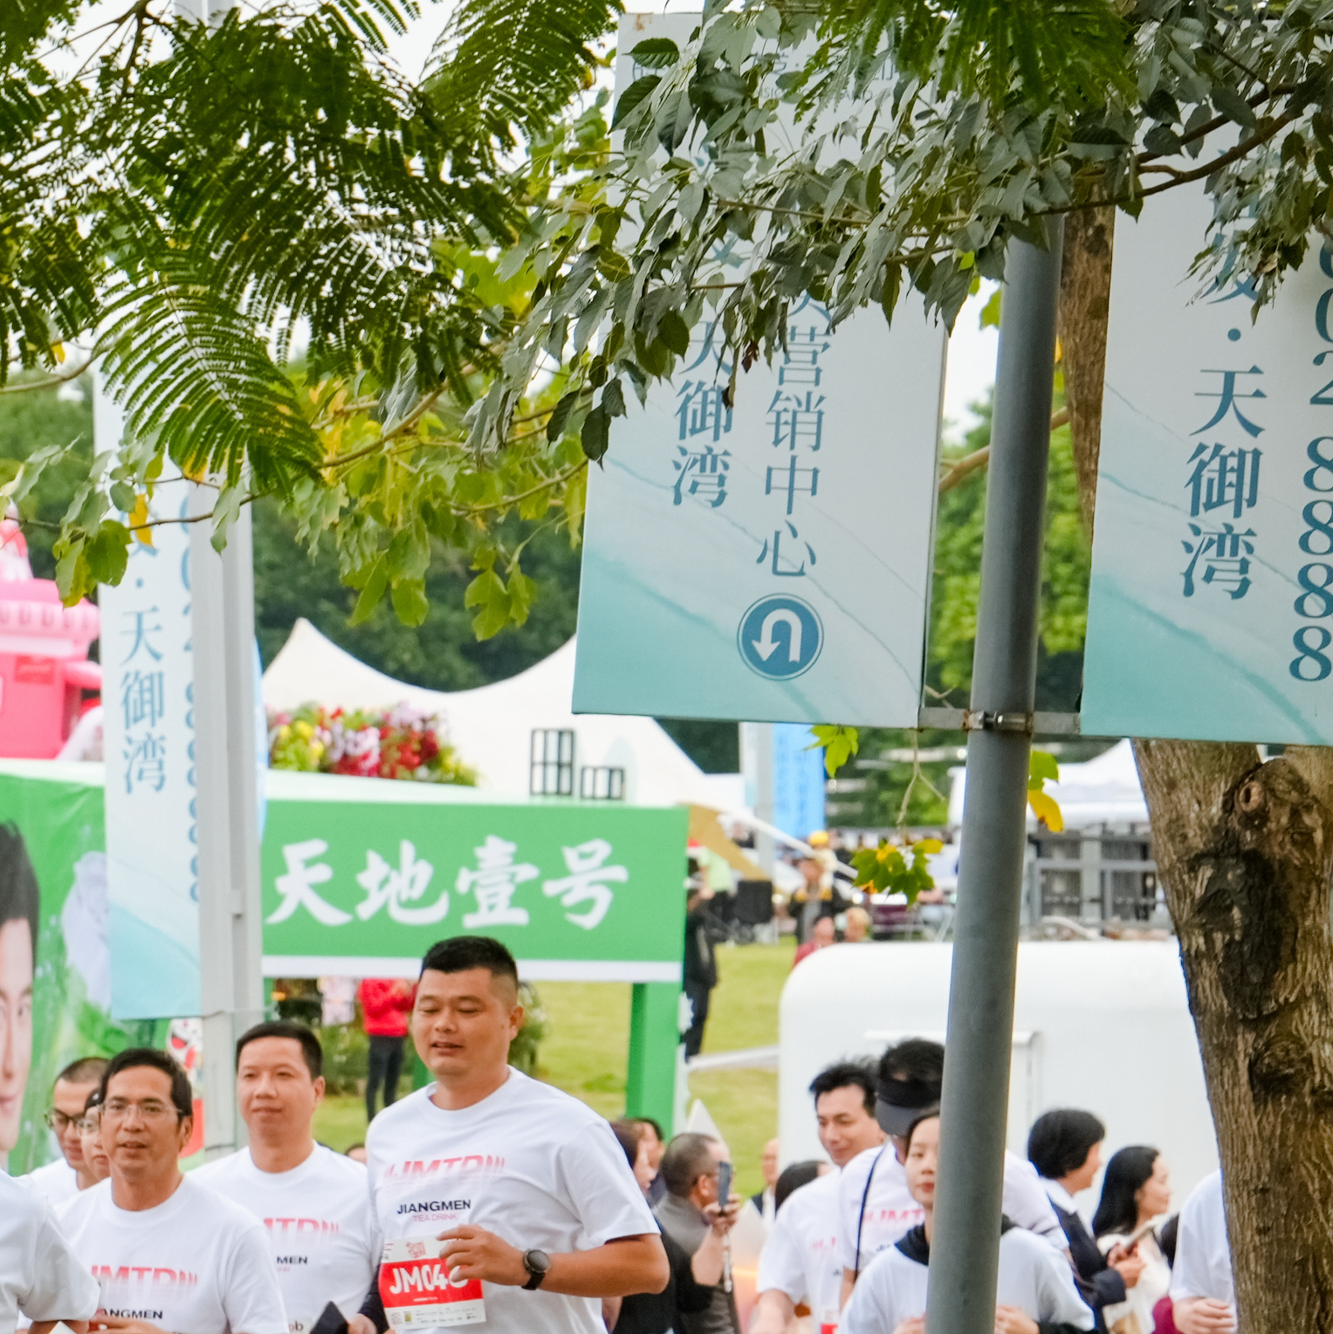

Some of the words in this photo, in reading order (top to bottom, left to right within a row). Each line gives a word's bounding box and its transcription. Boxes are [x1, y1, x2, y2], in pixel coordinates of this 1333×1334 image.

[266, 834, 629, 931] 天地壹号
[396, 1199, 472, 1215] JIANGMEN
